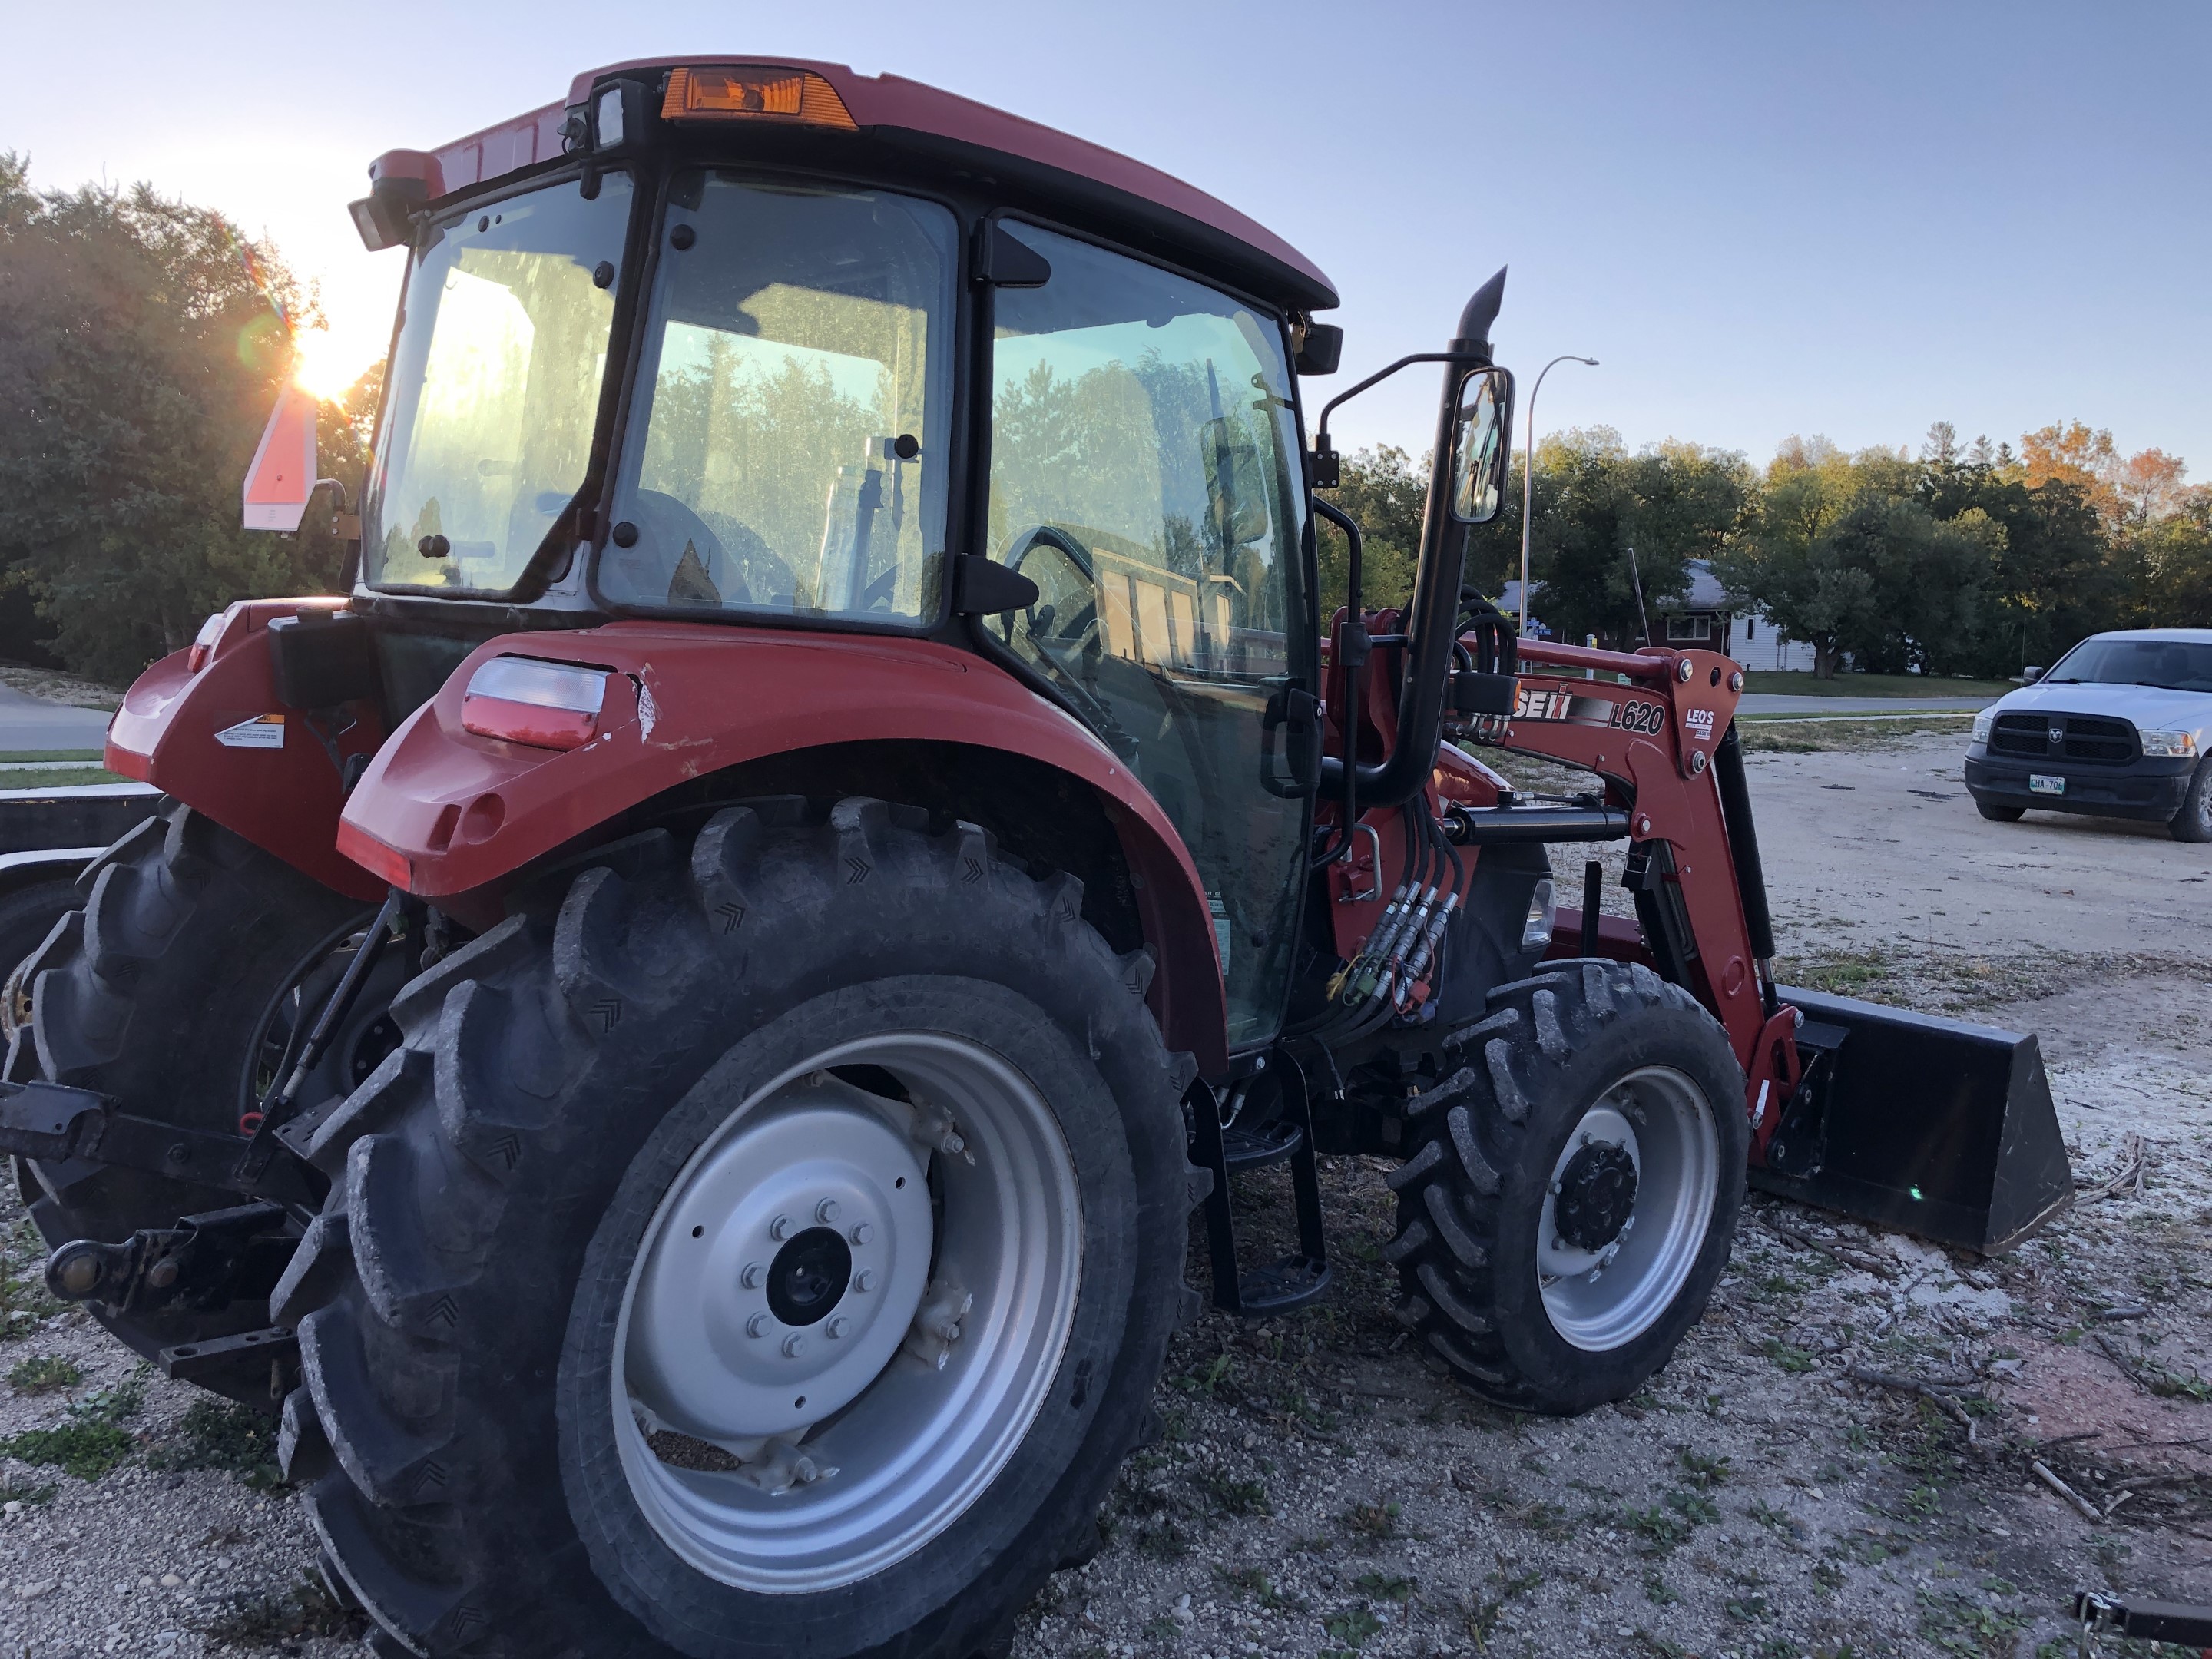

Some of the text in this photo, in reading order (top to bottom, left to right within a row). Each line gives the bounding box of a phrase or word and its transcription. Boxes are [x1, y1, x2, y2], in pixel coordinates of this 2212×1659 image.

[1512, 690, 1546, 718] SE
[1609, 700, 1666, 737] L620
[1687, 708, 1714, 725] LEO'S
[2031, 779, 2063, 790] CHA 706
